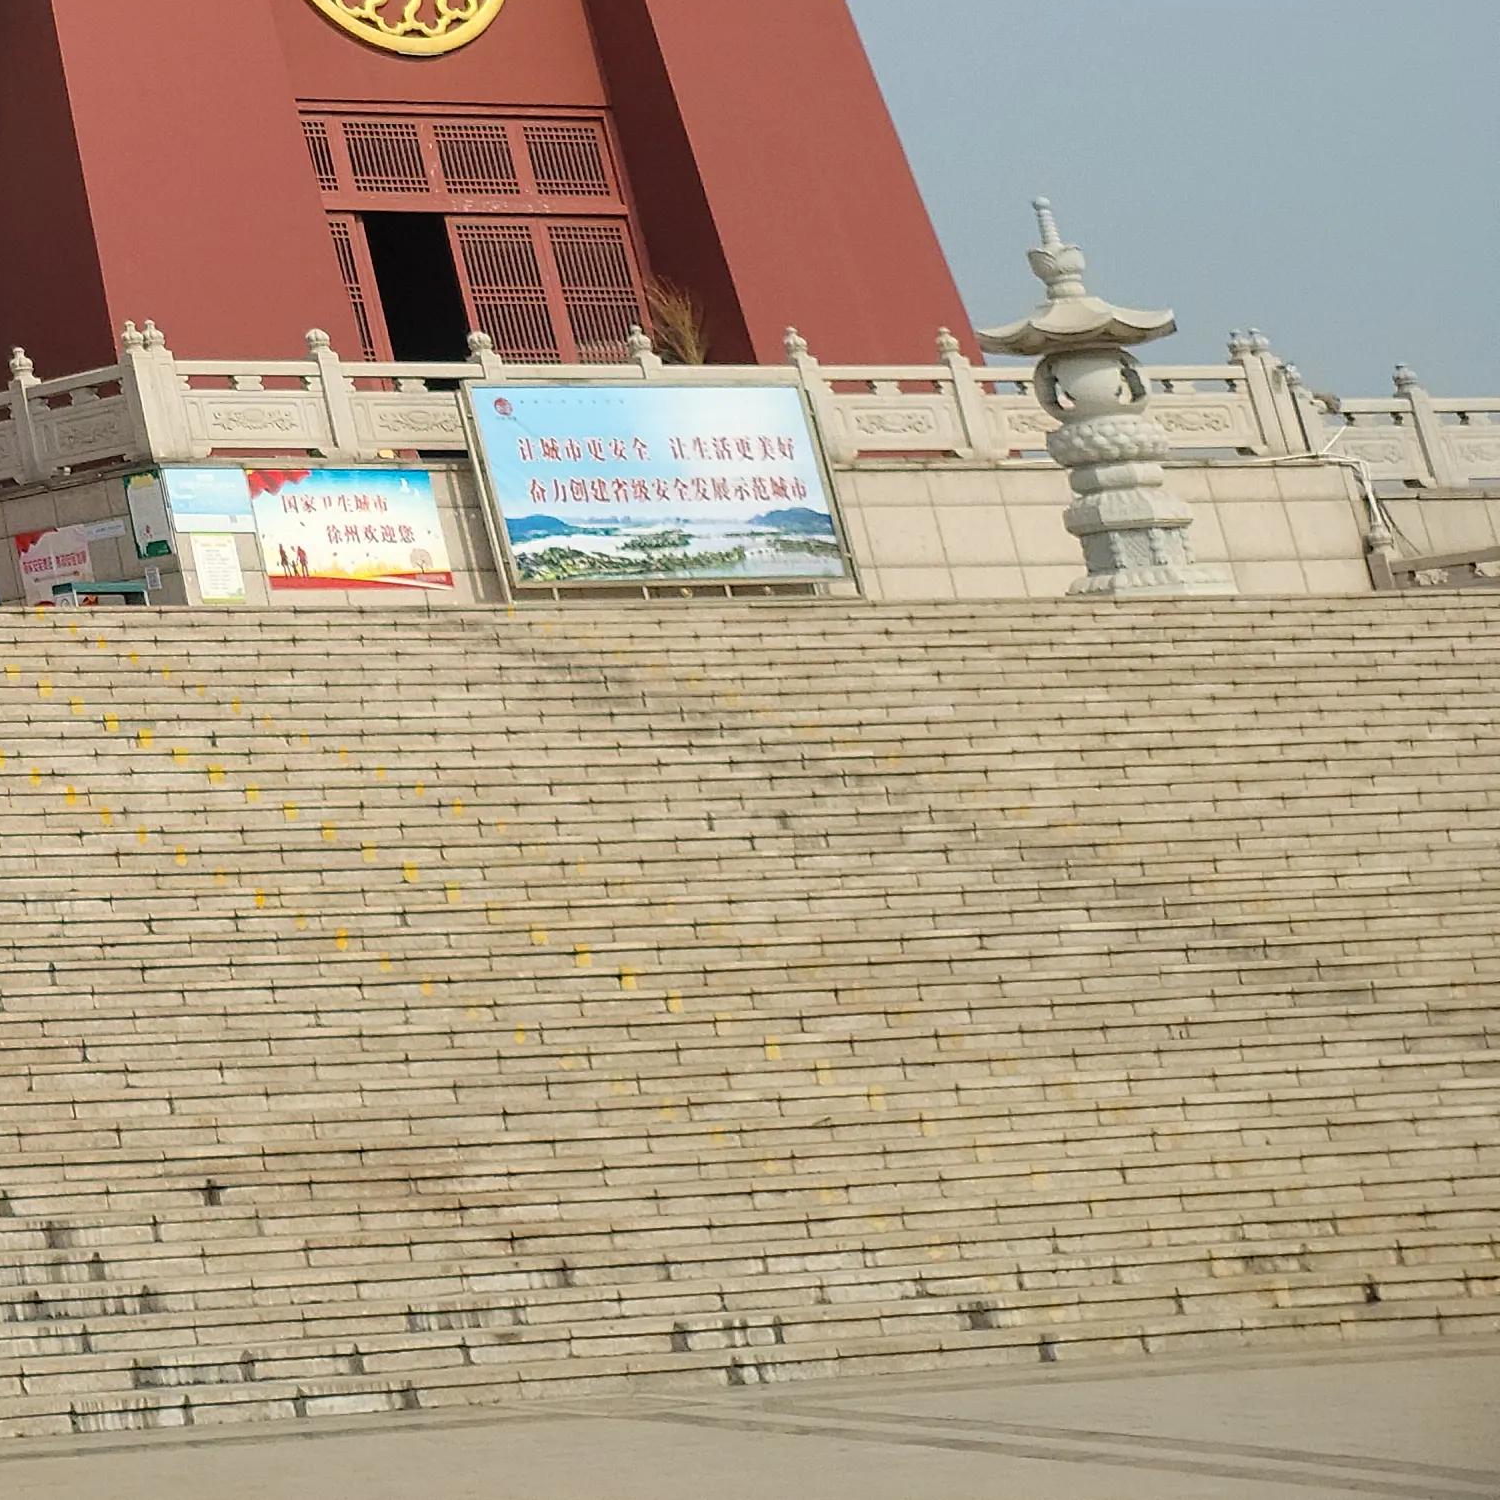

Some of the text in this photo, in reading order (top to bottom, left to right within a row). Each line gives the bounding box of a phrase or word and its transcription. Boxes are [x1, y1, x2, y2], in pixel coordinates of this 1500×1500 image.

[518, 435, 796, 462] 让城市更安全 让生活更美好
[529, 476, 808, 504] 奋力创建省级安全发展示范城市
[281, 493, 388, 514] 国家卫生城市
[326, 523, 416, 545] 徐州欢迎您
